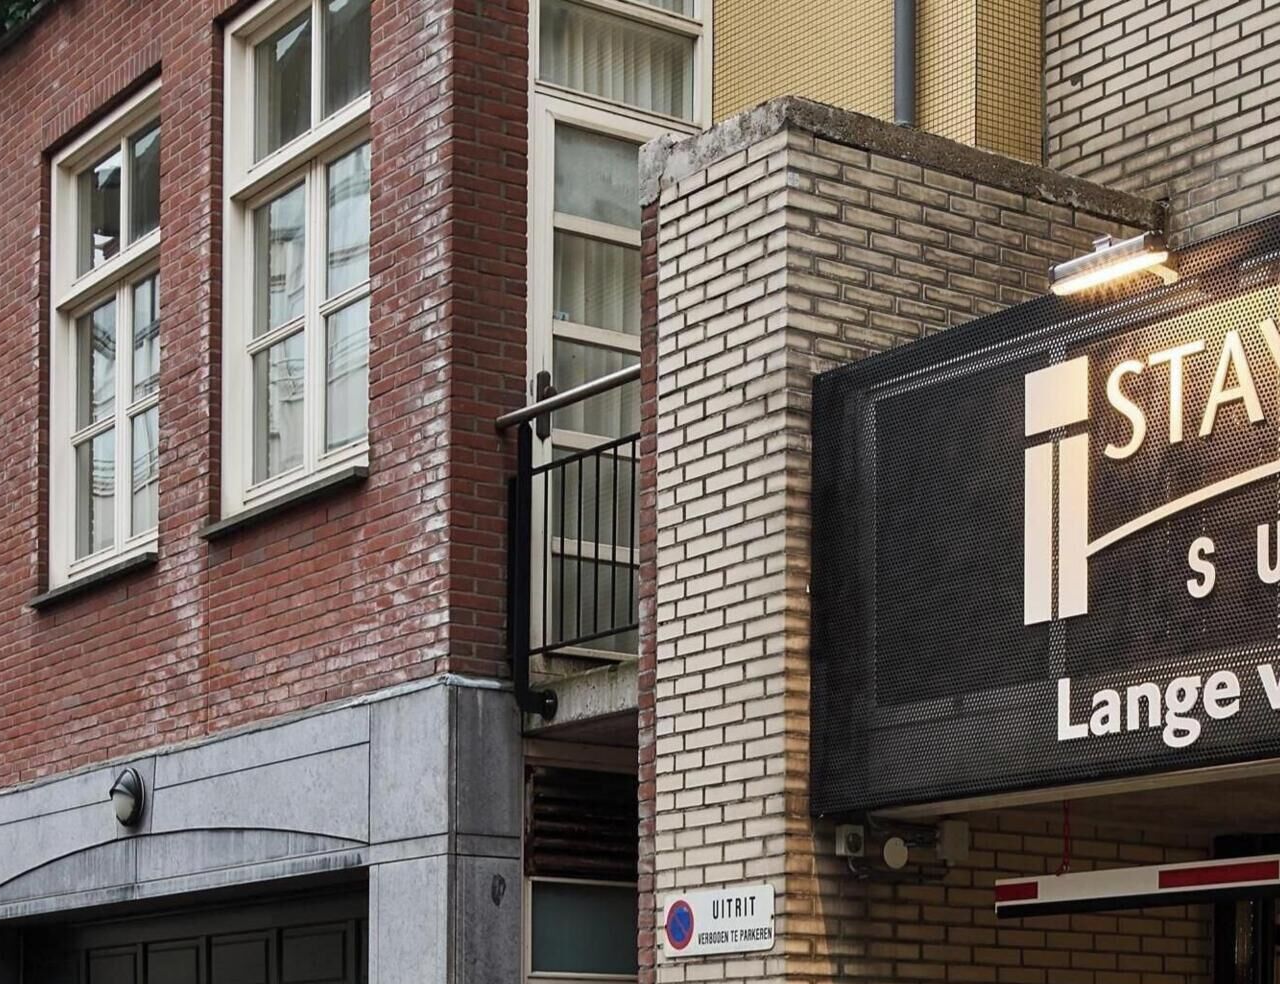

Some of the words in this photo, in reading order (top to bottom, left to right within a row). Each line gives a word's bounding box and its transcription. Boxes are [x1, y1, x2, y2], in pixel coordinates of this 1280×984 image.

[1056, 667, 1241, 749] Lange
[712, 896, 756, 919] UITRIT
[698, 930, 729, 945] VERBODEN
[730, 930, 738, 943] TE
[740, 927, 773, 942] PARKEREN
